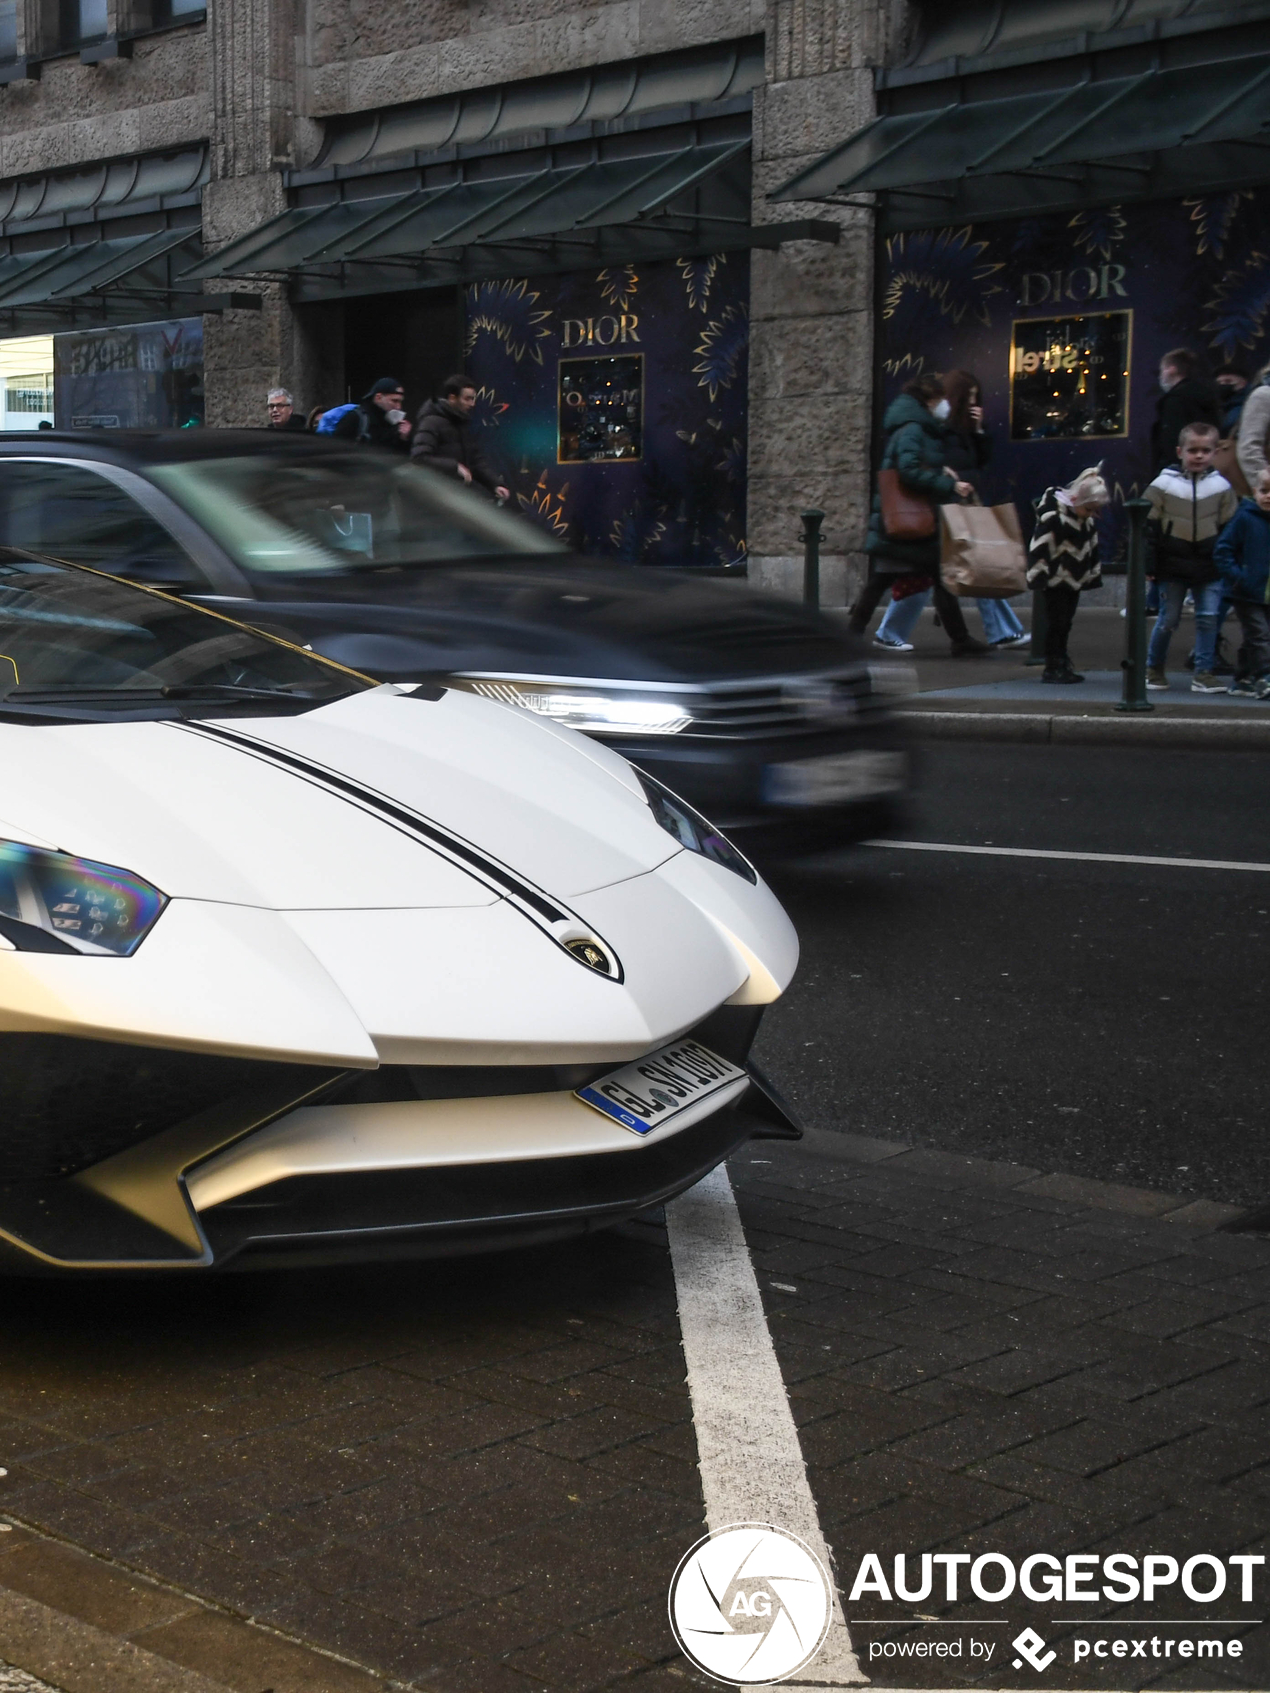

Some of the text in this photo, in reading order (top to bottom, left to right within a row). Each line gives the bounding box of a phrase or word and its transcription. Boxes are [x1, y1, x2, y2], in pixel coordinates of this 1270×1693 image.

[1018, 263, 1129, 306] DIOR
[561, 314, 641, 348] DIOR
[601, 1080, 666, 1118] GL
[637, 1060, 699, 1098] SN
[620, 1114, 636, 1125] D
